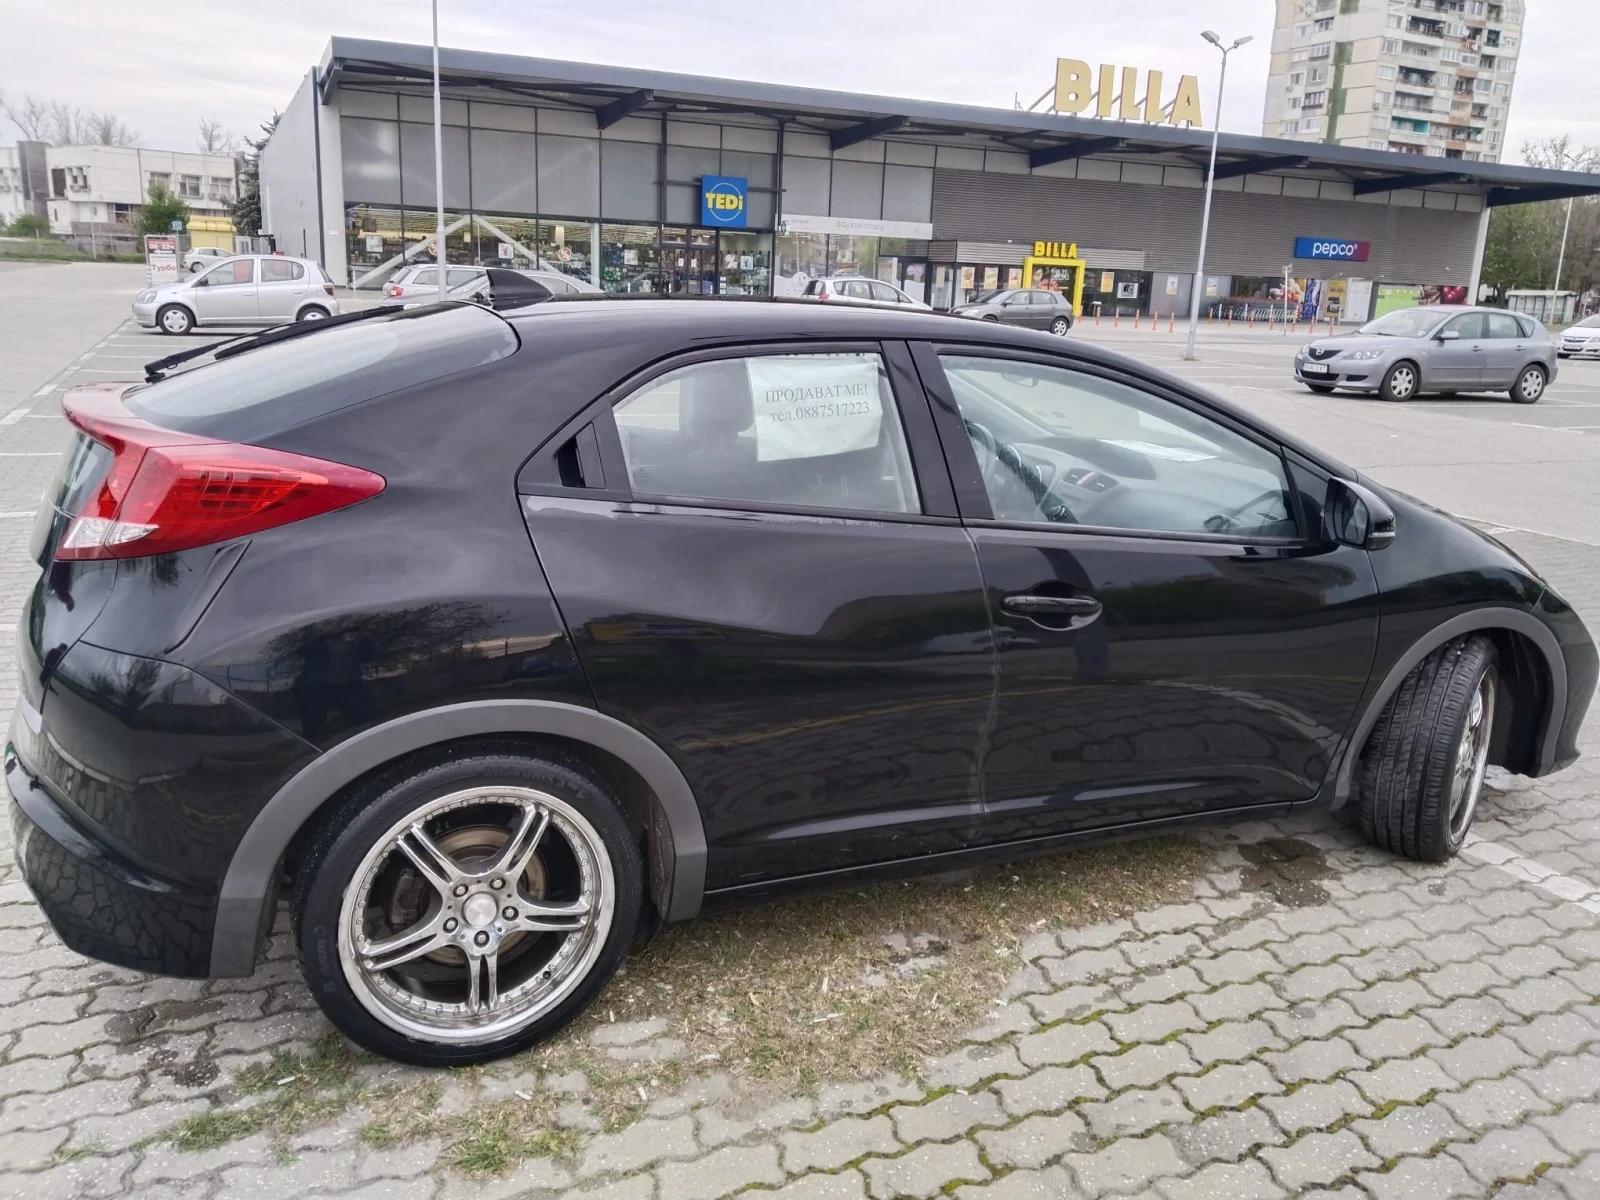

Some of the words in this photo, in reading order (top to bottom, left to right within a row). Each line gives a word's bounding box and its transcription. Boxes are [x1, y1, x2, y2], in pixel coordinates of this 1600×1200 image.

[1054, 57, 1202, 127] BILLA
[705, 192, 744, 211] TEDi
[1033, 240, 1078, 258] BILLA
[152, 264, 176, 272] Турбо
[765, 384, 842, 403] ПРОДАВАТ
[845, 383, 868, 397] МЕ!
